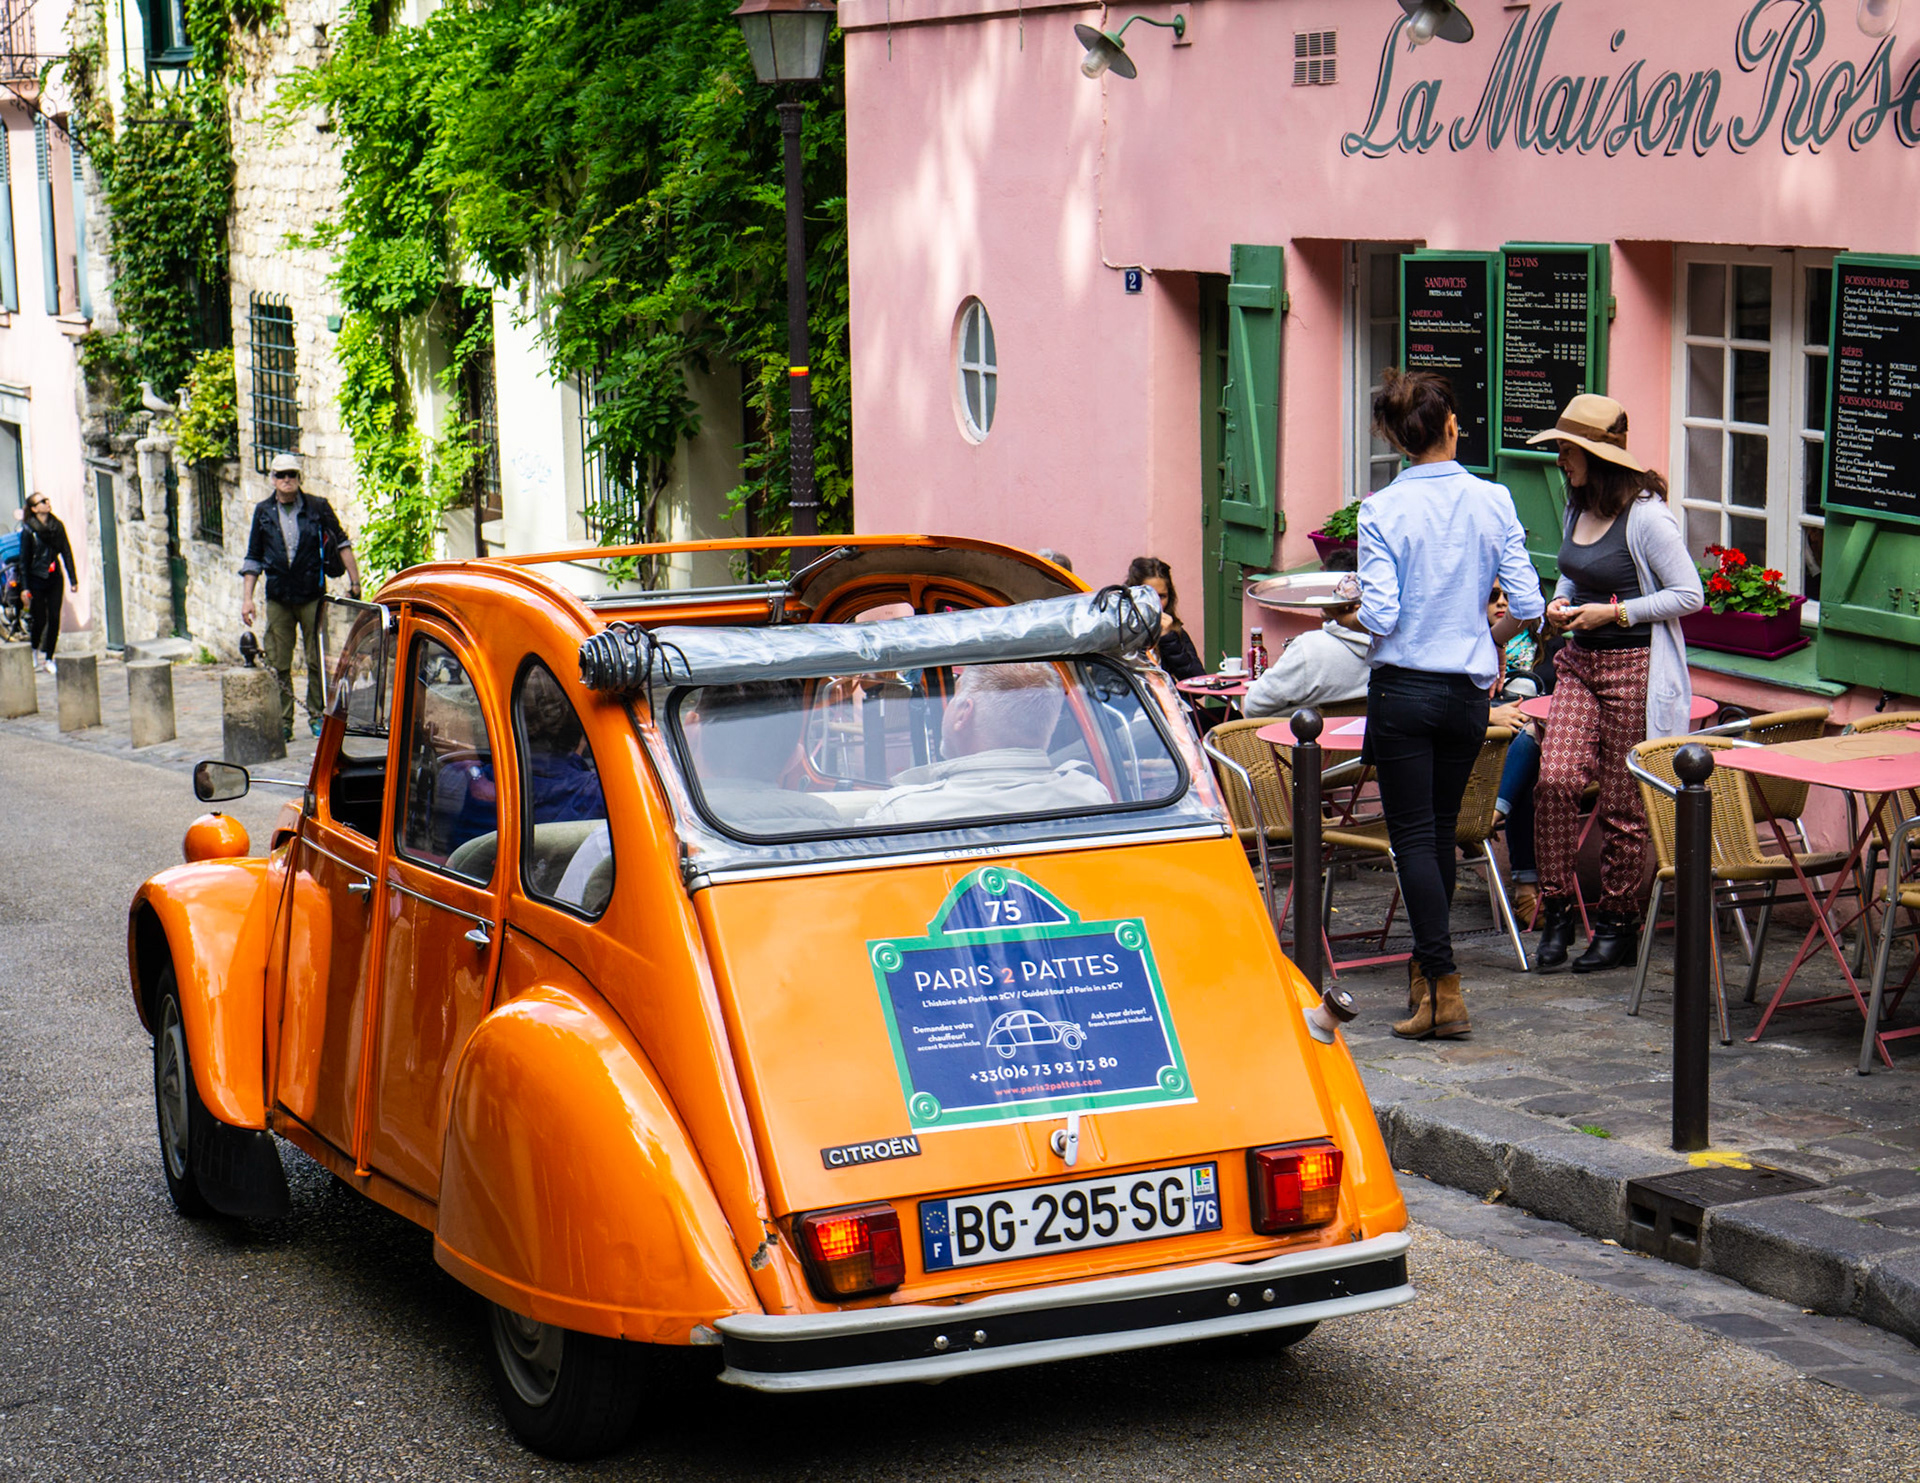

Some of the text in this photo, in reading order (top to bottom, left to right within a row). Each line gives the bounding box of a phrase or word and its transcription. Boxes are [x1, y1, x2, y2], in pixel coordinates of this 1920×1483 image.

[1341, 13, 1444, 158] La
[1450, 1, 1723, 158] Maison
[1508, 257, 1539, 268] LES VINS
[1129, 272, 1137, 289] 2
[1424, 276, 1467, 288] SANDWICHS
[1844, 275, 1877, 286] BOISSONS
[1841, 345, 1863, 357] BIÈRES
[1839, 394, 1904, 412] BOISSONS CHAUDES
[984, 900, 1022, 923] 75
[914, 953, 1120, 992] PARIS 2 PATTES
[922, 997, 957, 1009] L'histoire
[958, 996, 968, 1005] de
[968, 994, 988, 1004] Paris
[989, 994, 999, 1002] en
[999, 991, 1016, 1001] 2CV
[1021, 988, 1049, 999] Guided
[1050, 987, 1065, 997] tour
[1065, 985, 1074, 995] of
[1074, 983, 1093, 994] Paris
[1093, 983, 1101, 992] in
[1107, 981, 1124, 991] 2CV
[1091, 1007, 1147, 1020] Ask your driver!
[1108, 1018, 1128, 1026] accent
[1128, 1015, 1153, 1023] included
[912, 1022, 974, 1034] Demandez votre
[927, 1032, 966, 1043] chauffeur!
[970, 1057, 1118, 1083] +33(0)6 73 93 73 80
[994, 1078, 1103, 1096] www.paris2pattes.com
[828, 1137, 918, 1165] CITROËN
[955, 1177, 1186, 1257] BG-295-SG
[1194, 1199, 1217, 1226] 76
[933, 1242, 943, 1258] F
